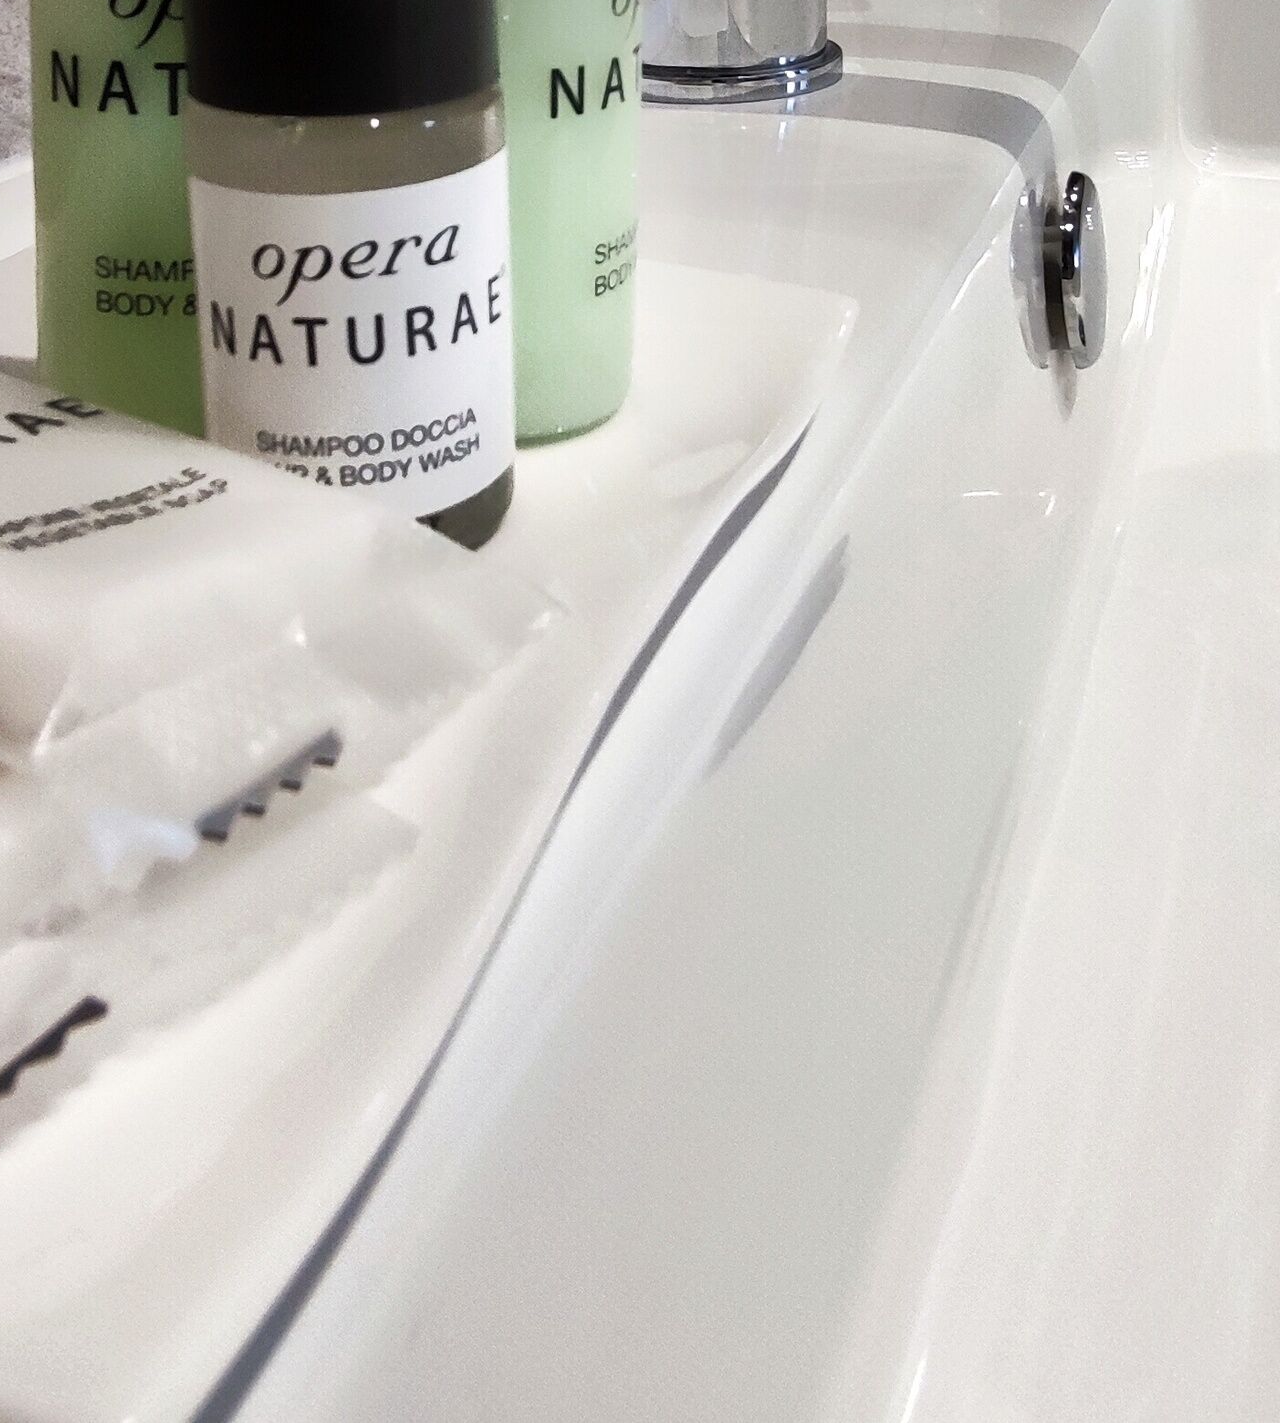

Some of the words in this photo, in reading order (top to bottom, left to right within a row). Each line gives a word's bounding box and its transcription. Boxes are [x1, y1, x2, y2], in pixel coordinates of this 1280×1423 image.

[51, 49, 188, 116] NAT
[251, 224, 460, 306] opera
[96, 289, 174, 316] BODY
[209, 273, 502, 367] NATURAE
[256, 429, 384, 458] SHAMPOO
[391, 407, 477, 453] DOCCIA
[339, 456, 412, 487] BODY
[419, 432, 481, 473] WASH
